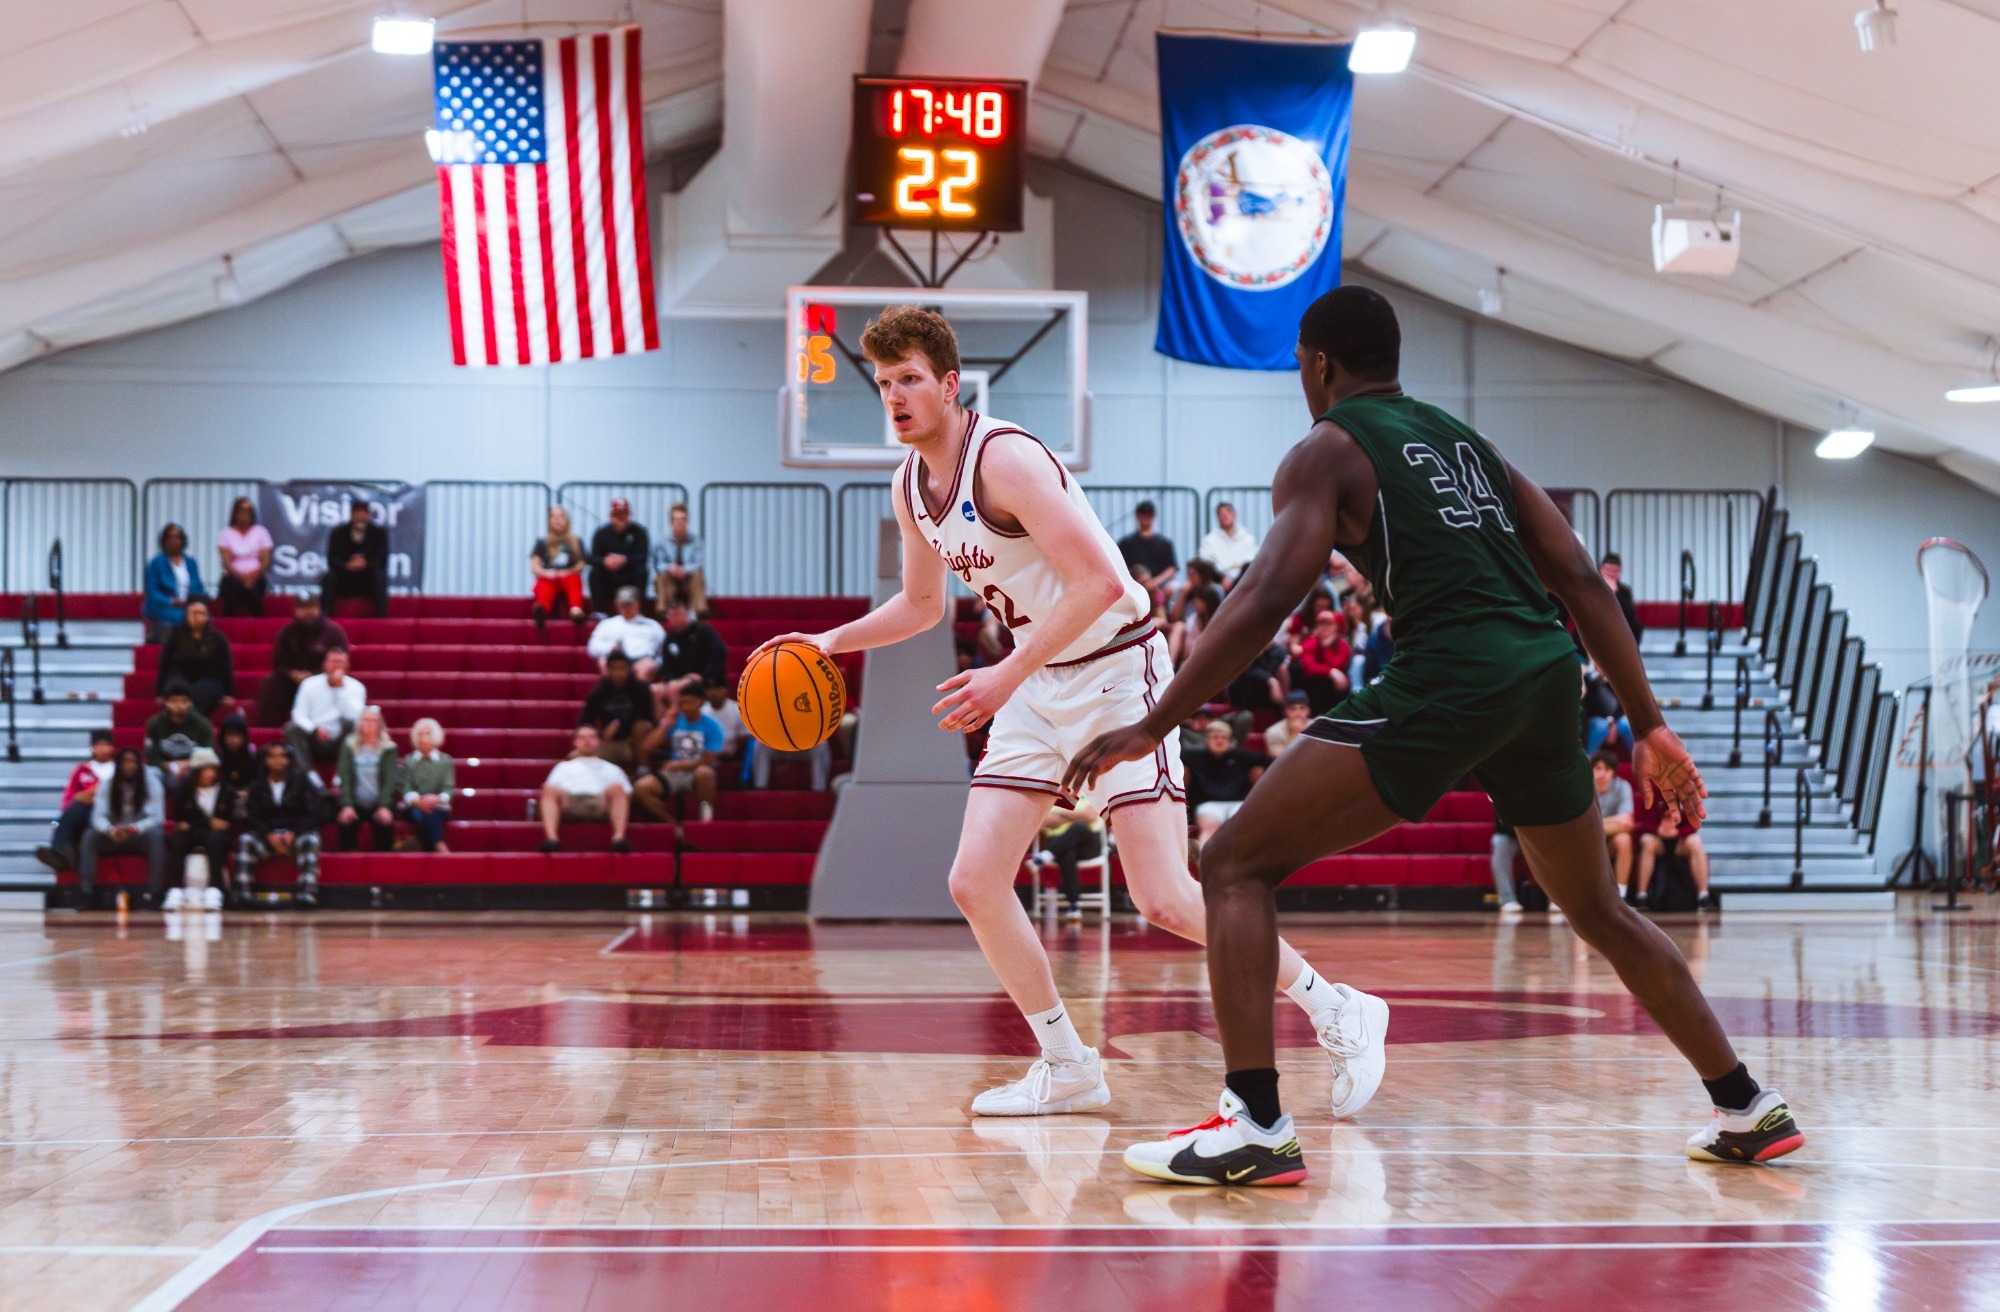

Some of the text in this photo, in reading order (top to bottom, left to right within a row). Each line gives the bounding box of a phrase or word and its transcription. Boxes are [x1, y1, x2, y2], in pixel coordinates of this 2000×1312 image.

[891, 87, 1004, 140] 17:48
[895, 147, 980, 216] 22
[278, 493, 404, 527] Visior
[1402, 441, 1515, 533] 34
[972, 584, 1032, 630] 2
